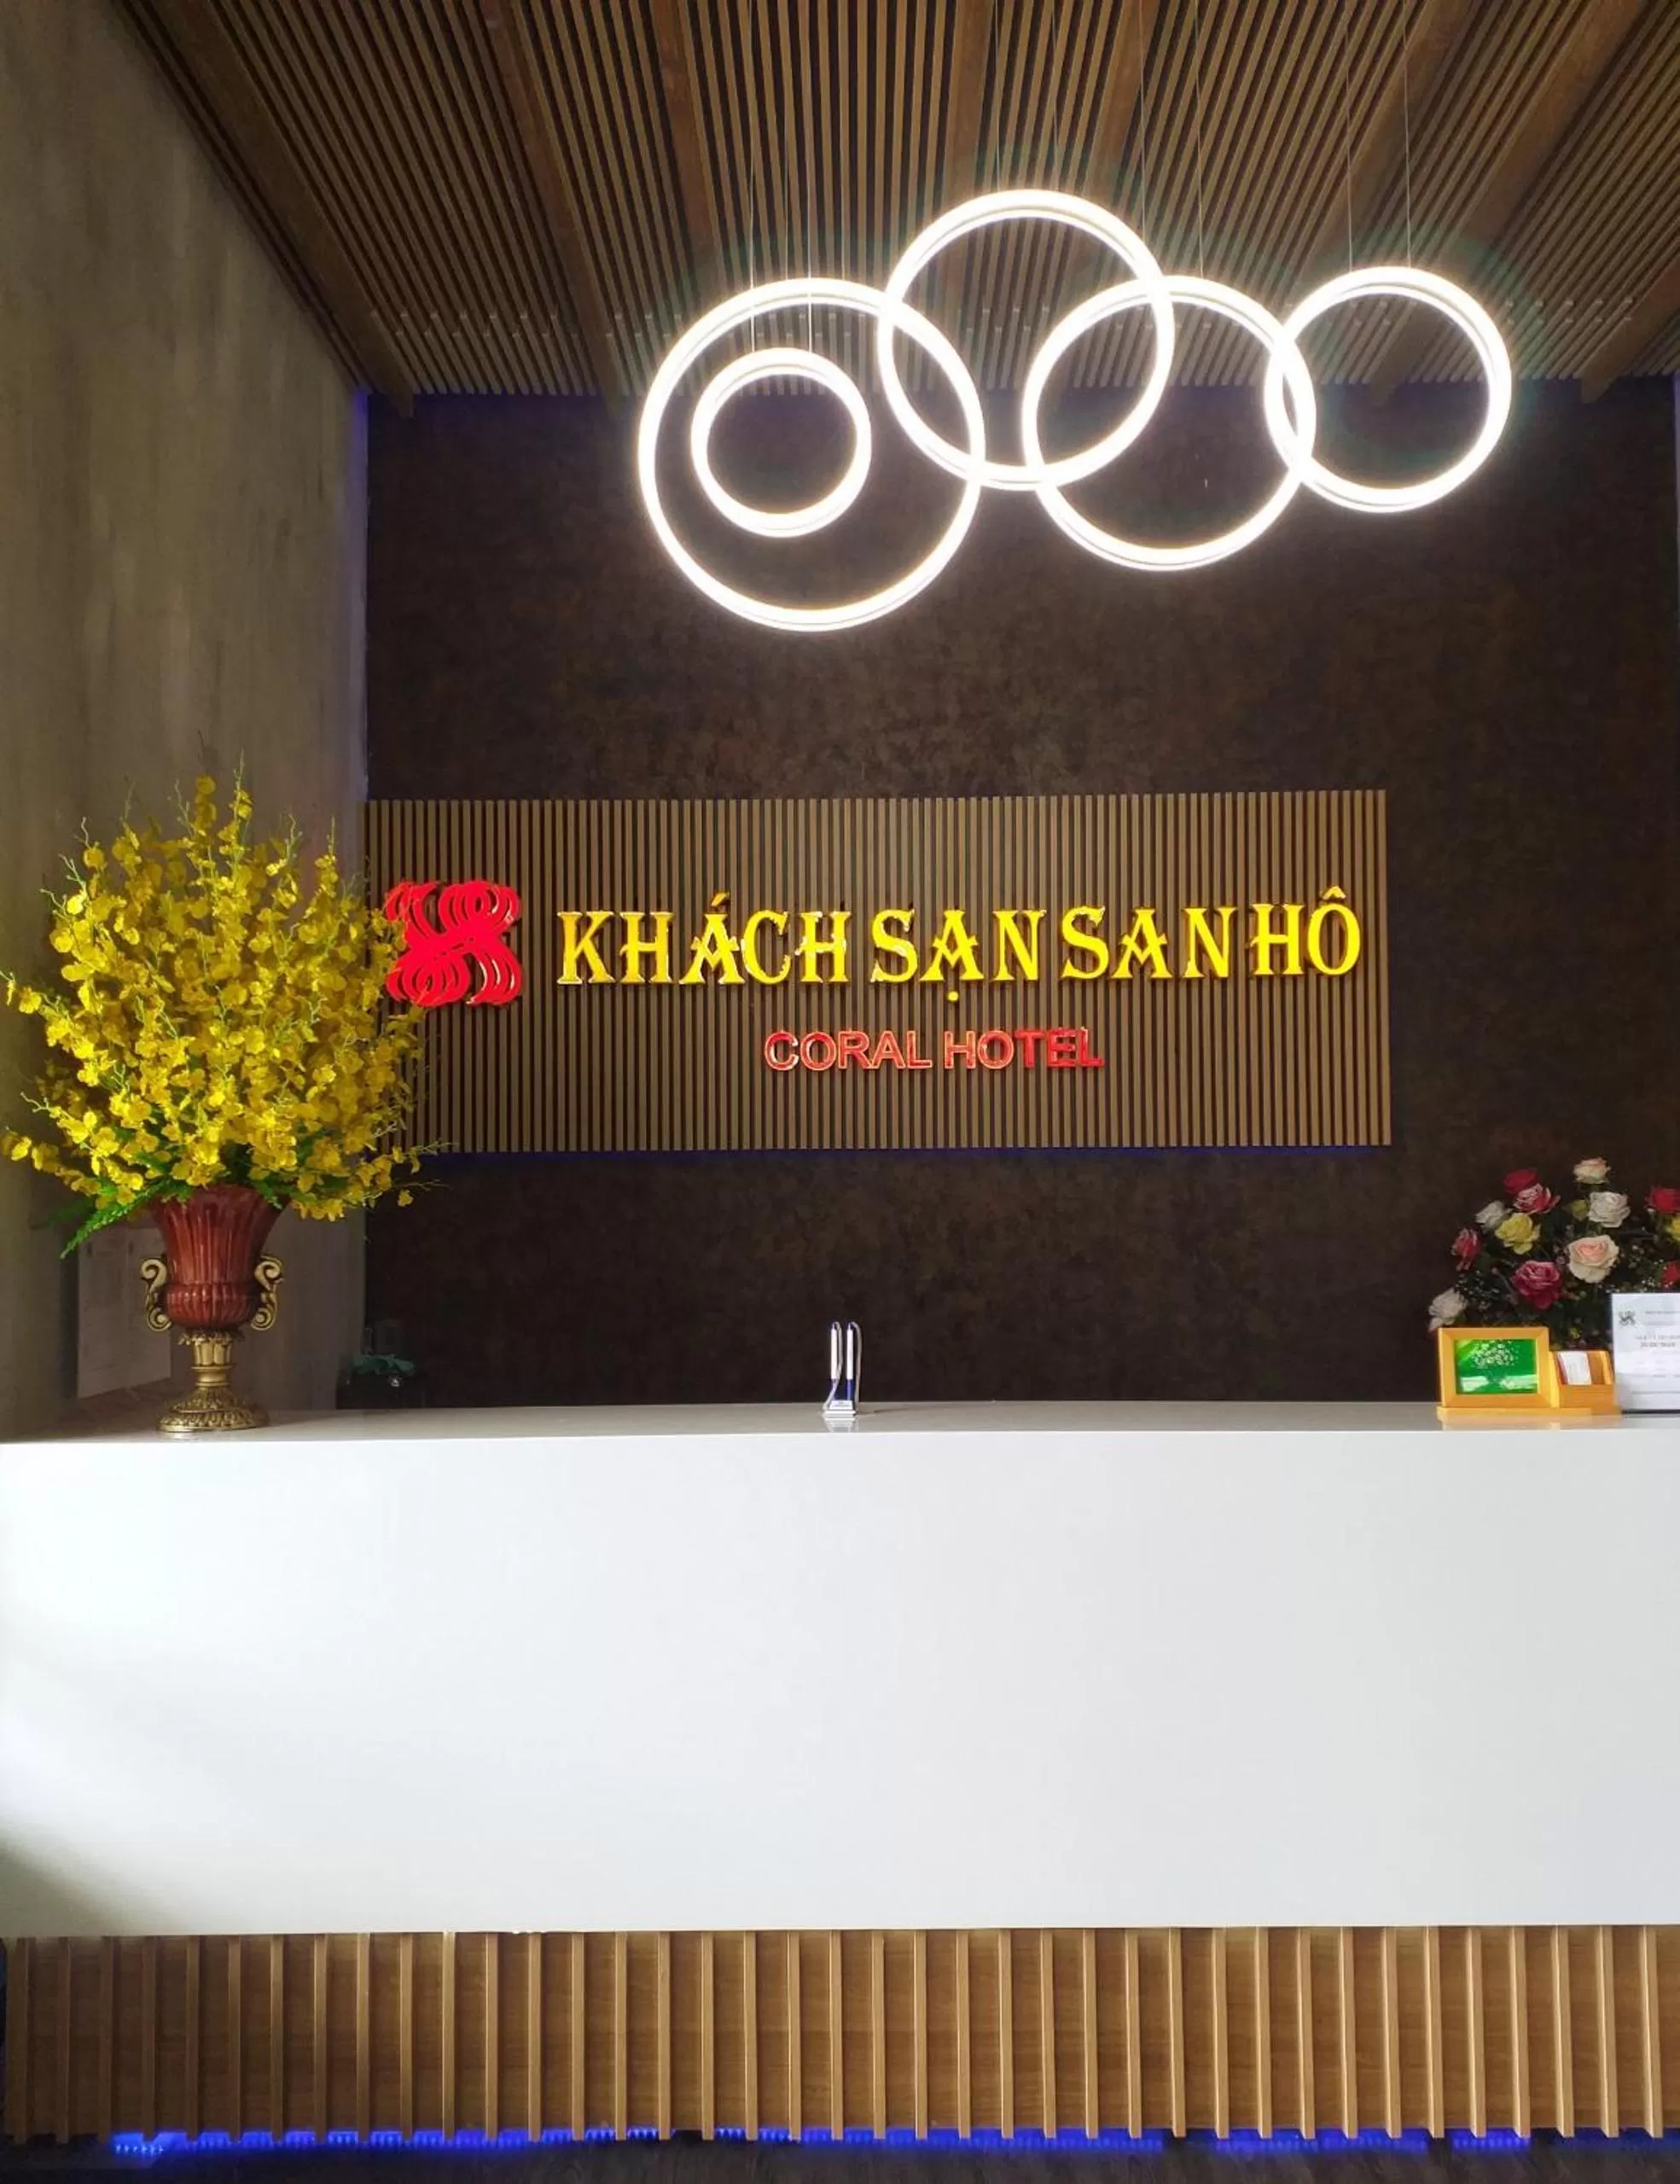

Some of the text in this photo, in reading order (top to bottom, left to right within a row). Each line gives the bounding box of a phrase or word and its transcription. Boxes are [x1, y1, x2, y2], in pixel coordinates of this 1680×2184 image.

[557, 885, 1362, 1002] KHÁCH SẠN SAN HÔ
[764, 1028, 1104, 1071] CORAL HOTEL
